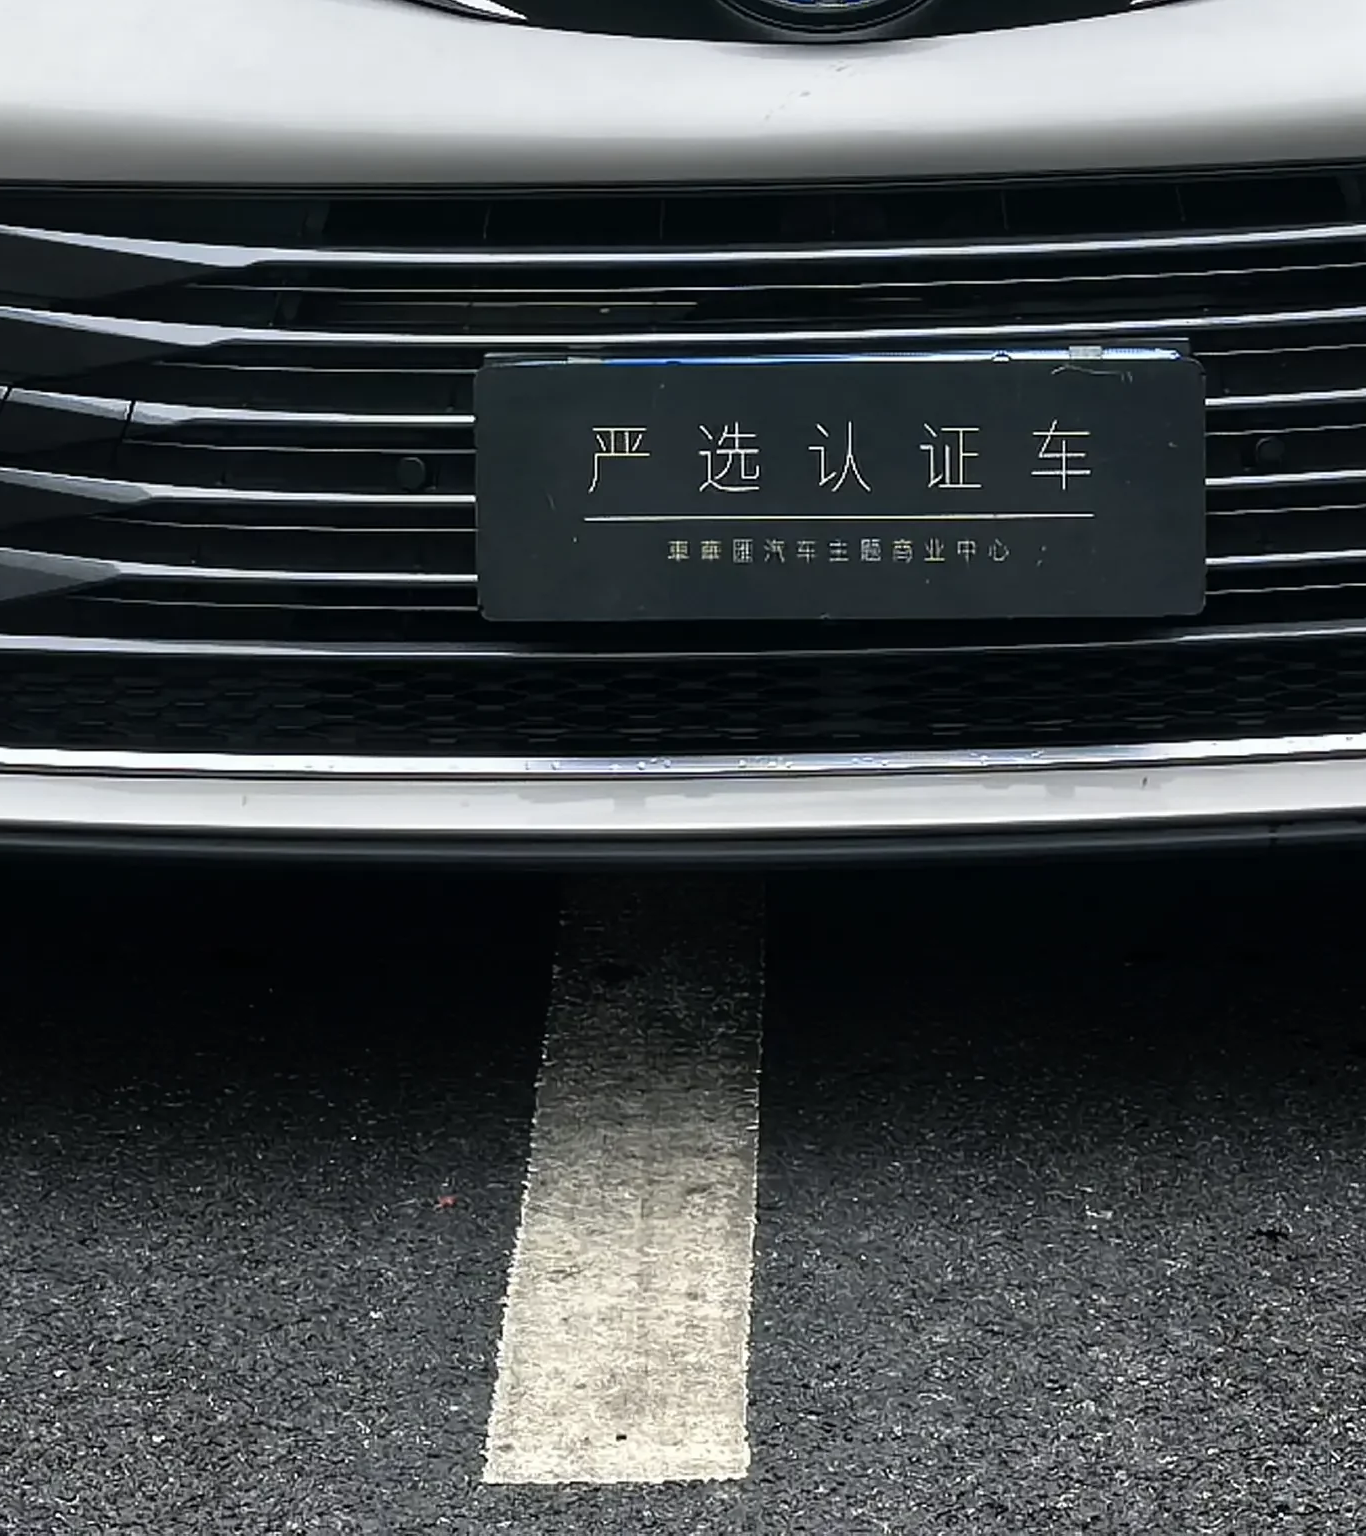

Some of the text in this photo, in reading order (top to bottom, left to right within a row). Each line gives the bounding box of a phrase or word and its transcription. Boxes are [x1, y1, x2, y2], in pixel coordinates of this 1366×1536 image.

[586, 419, 1094, 493] 严选认证车
